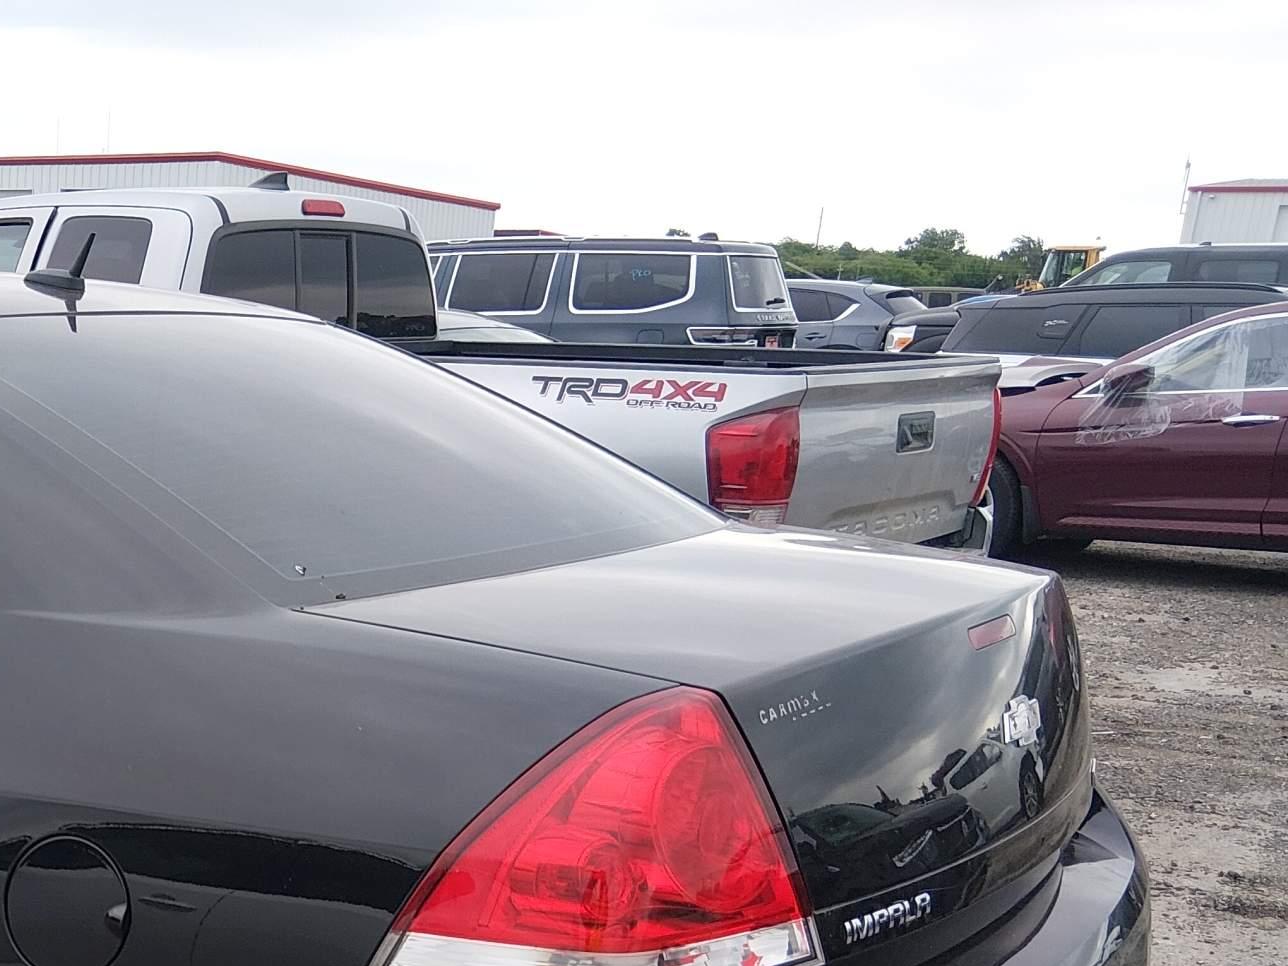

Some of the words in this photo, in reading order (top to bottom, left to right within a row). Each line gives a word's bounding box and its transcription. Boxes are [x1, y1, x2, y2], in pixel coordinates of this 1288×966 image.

[531, 376, 629, 403] TRD
[626, 400, 662, 408] OFF
[665, 401, 718, 412] ROAD
[844, 892, 931, 945] IMPALA
